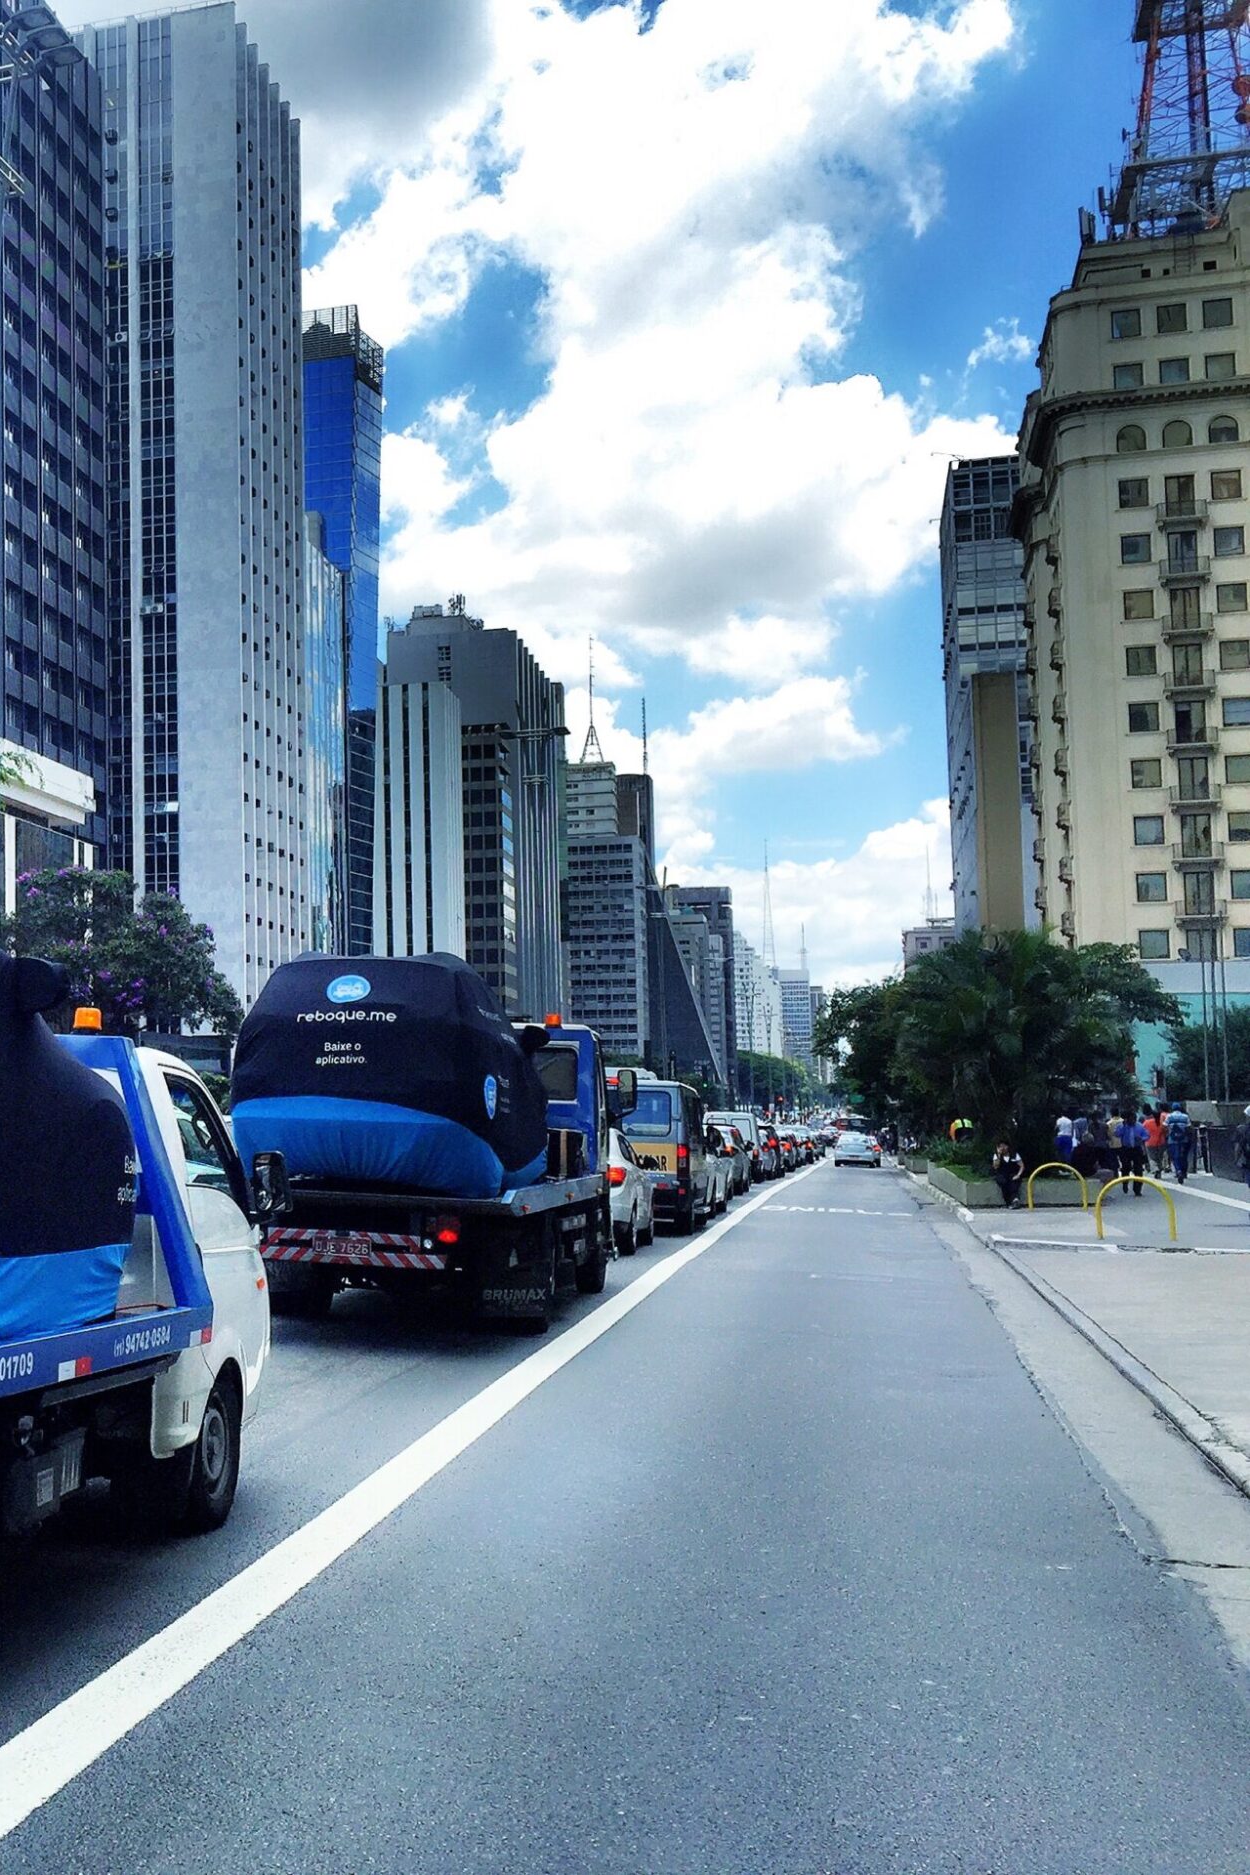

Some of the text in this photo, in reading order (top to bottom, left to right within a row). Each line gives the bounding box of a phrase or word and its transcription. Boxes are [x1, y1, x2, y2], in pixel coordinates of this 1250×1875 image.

[296, 1010, 398, 1024] reboque.me
[324, 1041, 362, 1052] Baixe o
[315, 1054, 368, 1067] aplicativo.
